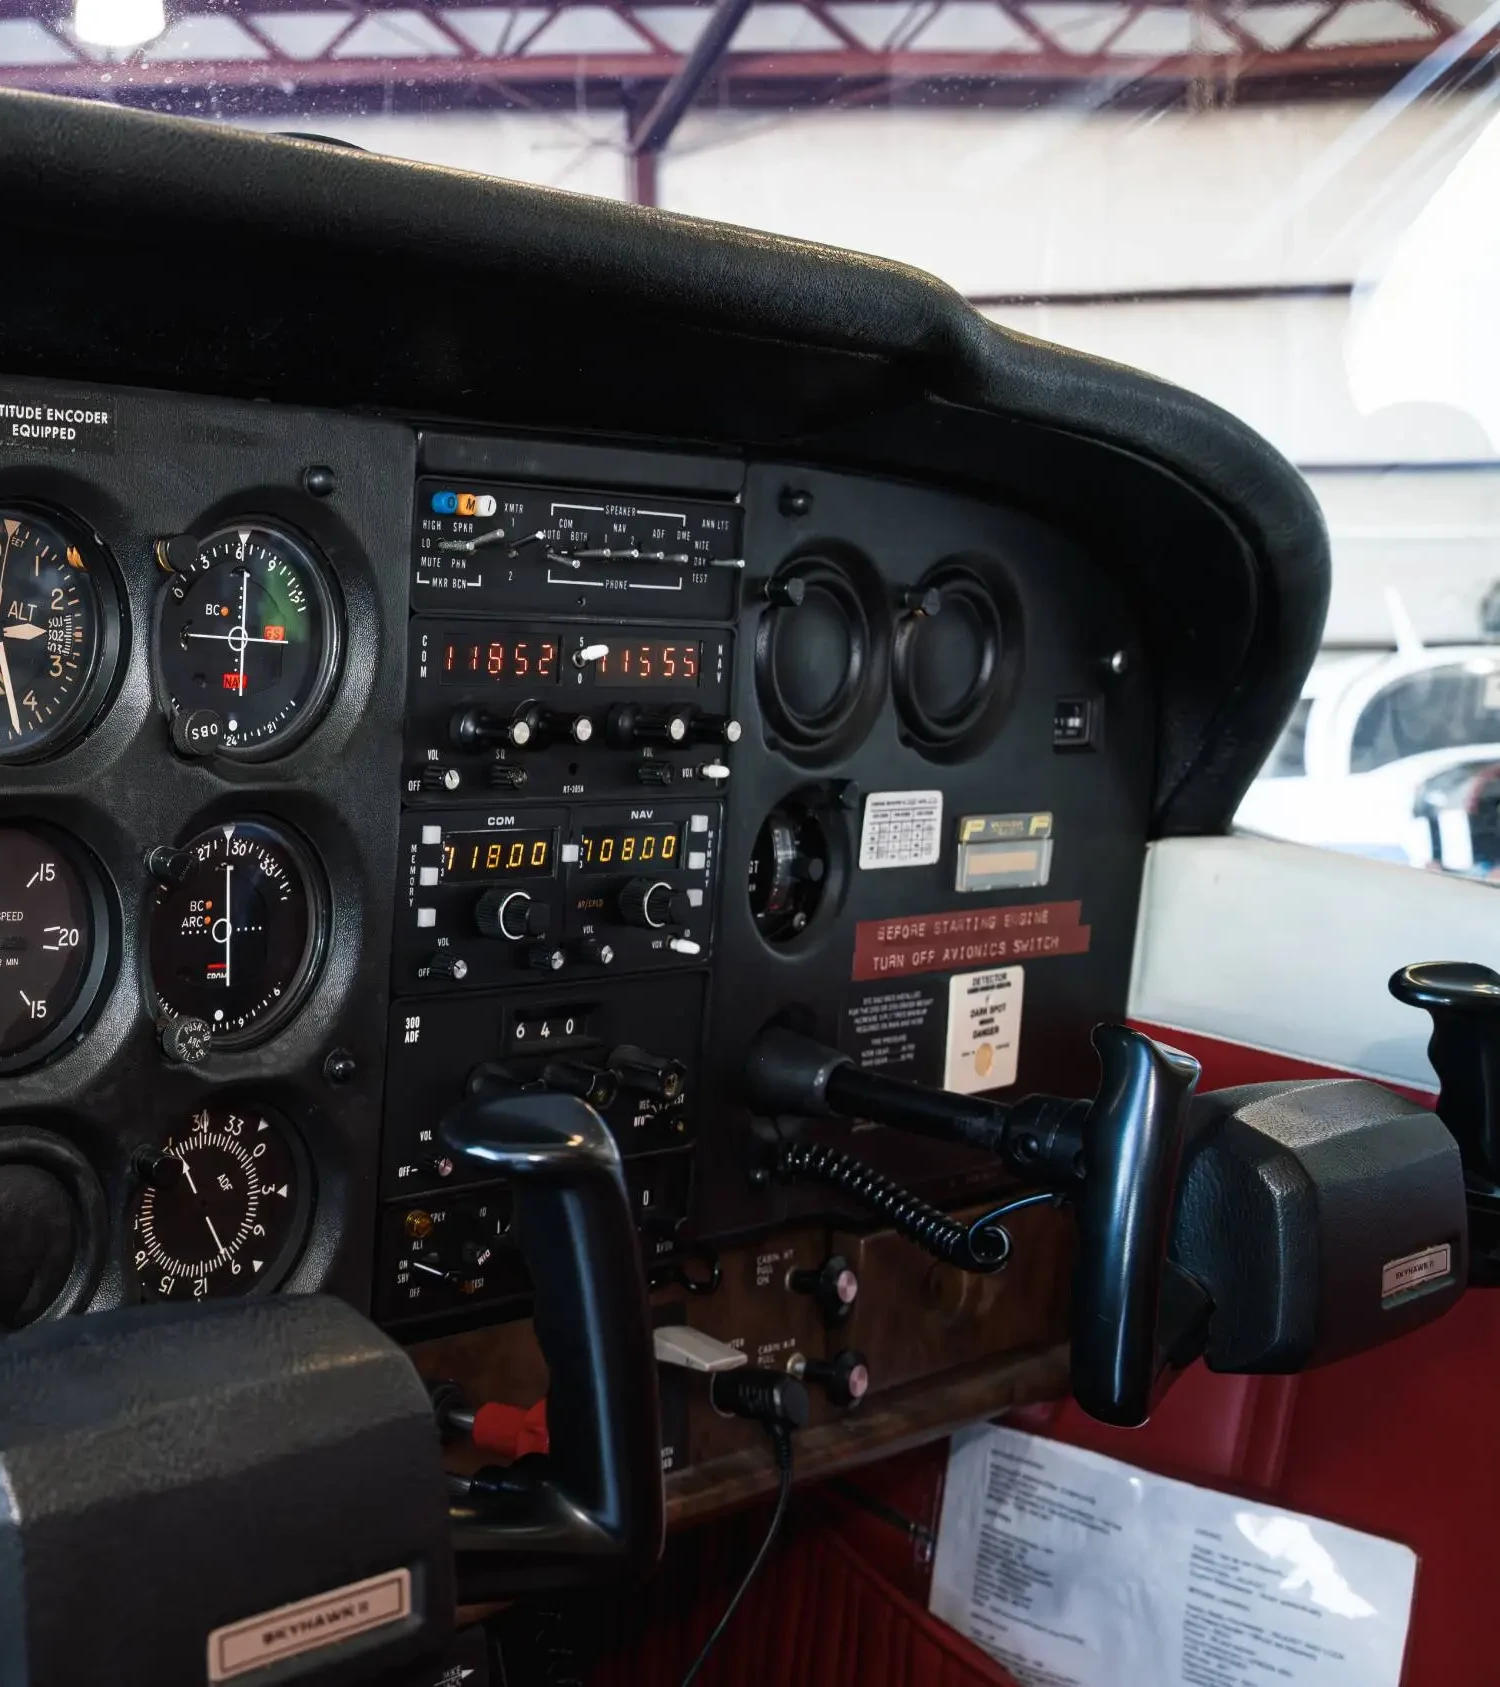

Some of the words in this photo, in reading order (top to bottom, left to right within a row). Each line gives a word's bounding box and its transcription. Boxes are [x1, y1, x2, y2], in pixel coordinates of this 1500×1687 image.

[45, 406, 109, 426] ENCODER
[12, 424, 77, 441] EQUIPPED
[504, 502, 525, 514] XMTR
[605, 504, 637, 518] SPEAKER
[422, 519, 442, 531] HIGH
[453, 522, 474, 533] SPKR
[558, 518, 574, 530] COM
[613, 523, 627, 534] NAV
[570, 530, 588, 541] BOTH
[652, 529, 666, 539] ADF
[694, 540, 710, 550] NITE
[420, 556, 442, 568] MUTE
[432, 577, 449, 588] MKR
[452, 579, 467, 590] BCN
[605, 579, 628, 591] PHONE
[51, 588, 64, 611] 2
[7, 600, 38, 622] ALT
[205, 603, 220, 616] BC
[49, 654, 63, 678] 3
[22, 689, 38, 712] 4
[408, 780, 421, 792] OFF
[487, 815, 515, 826] COM
[630, 810, 654, 820] NAV
[231, 841, 247, 856] 30
[40, 862, 56, 882] 15
[190, 900, 204, 912] BC
[181, 915, 204, 928] ARC
[876, 921, 926, 941] BEFORE
[933, 914, 997, 936] STARTING
[58, 928, 80, 947] 20
[872, 953, 905, 972] TURN
[911, 950, 935, 967] OFF
[942, 941, 1006, 962] AVIONICS
[1012, 936, 1060, 954] SWITCH
[5, 958, 19, 967] MIN
[972, 973, 1008, 987] DETECTOR
[31, 1000, 48, 1019] 15
[405, 1016, 420, 1030] 300
[404, 1030, 420, 1044] ADF
[973, 1025, 1000, 1040] DANGER
[224, 1114, 245, 1136] 33
[419, 1130, 432, 1142] VOL
[216, 1173, 234, 1192] ADF
[1395, 1260, 1429, 1280] SKYHAWK
[396, 1273, 410, 1285] SBY
[261, 1602, 356, 1646] SKYHAWK
